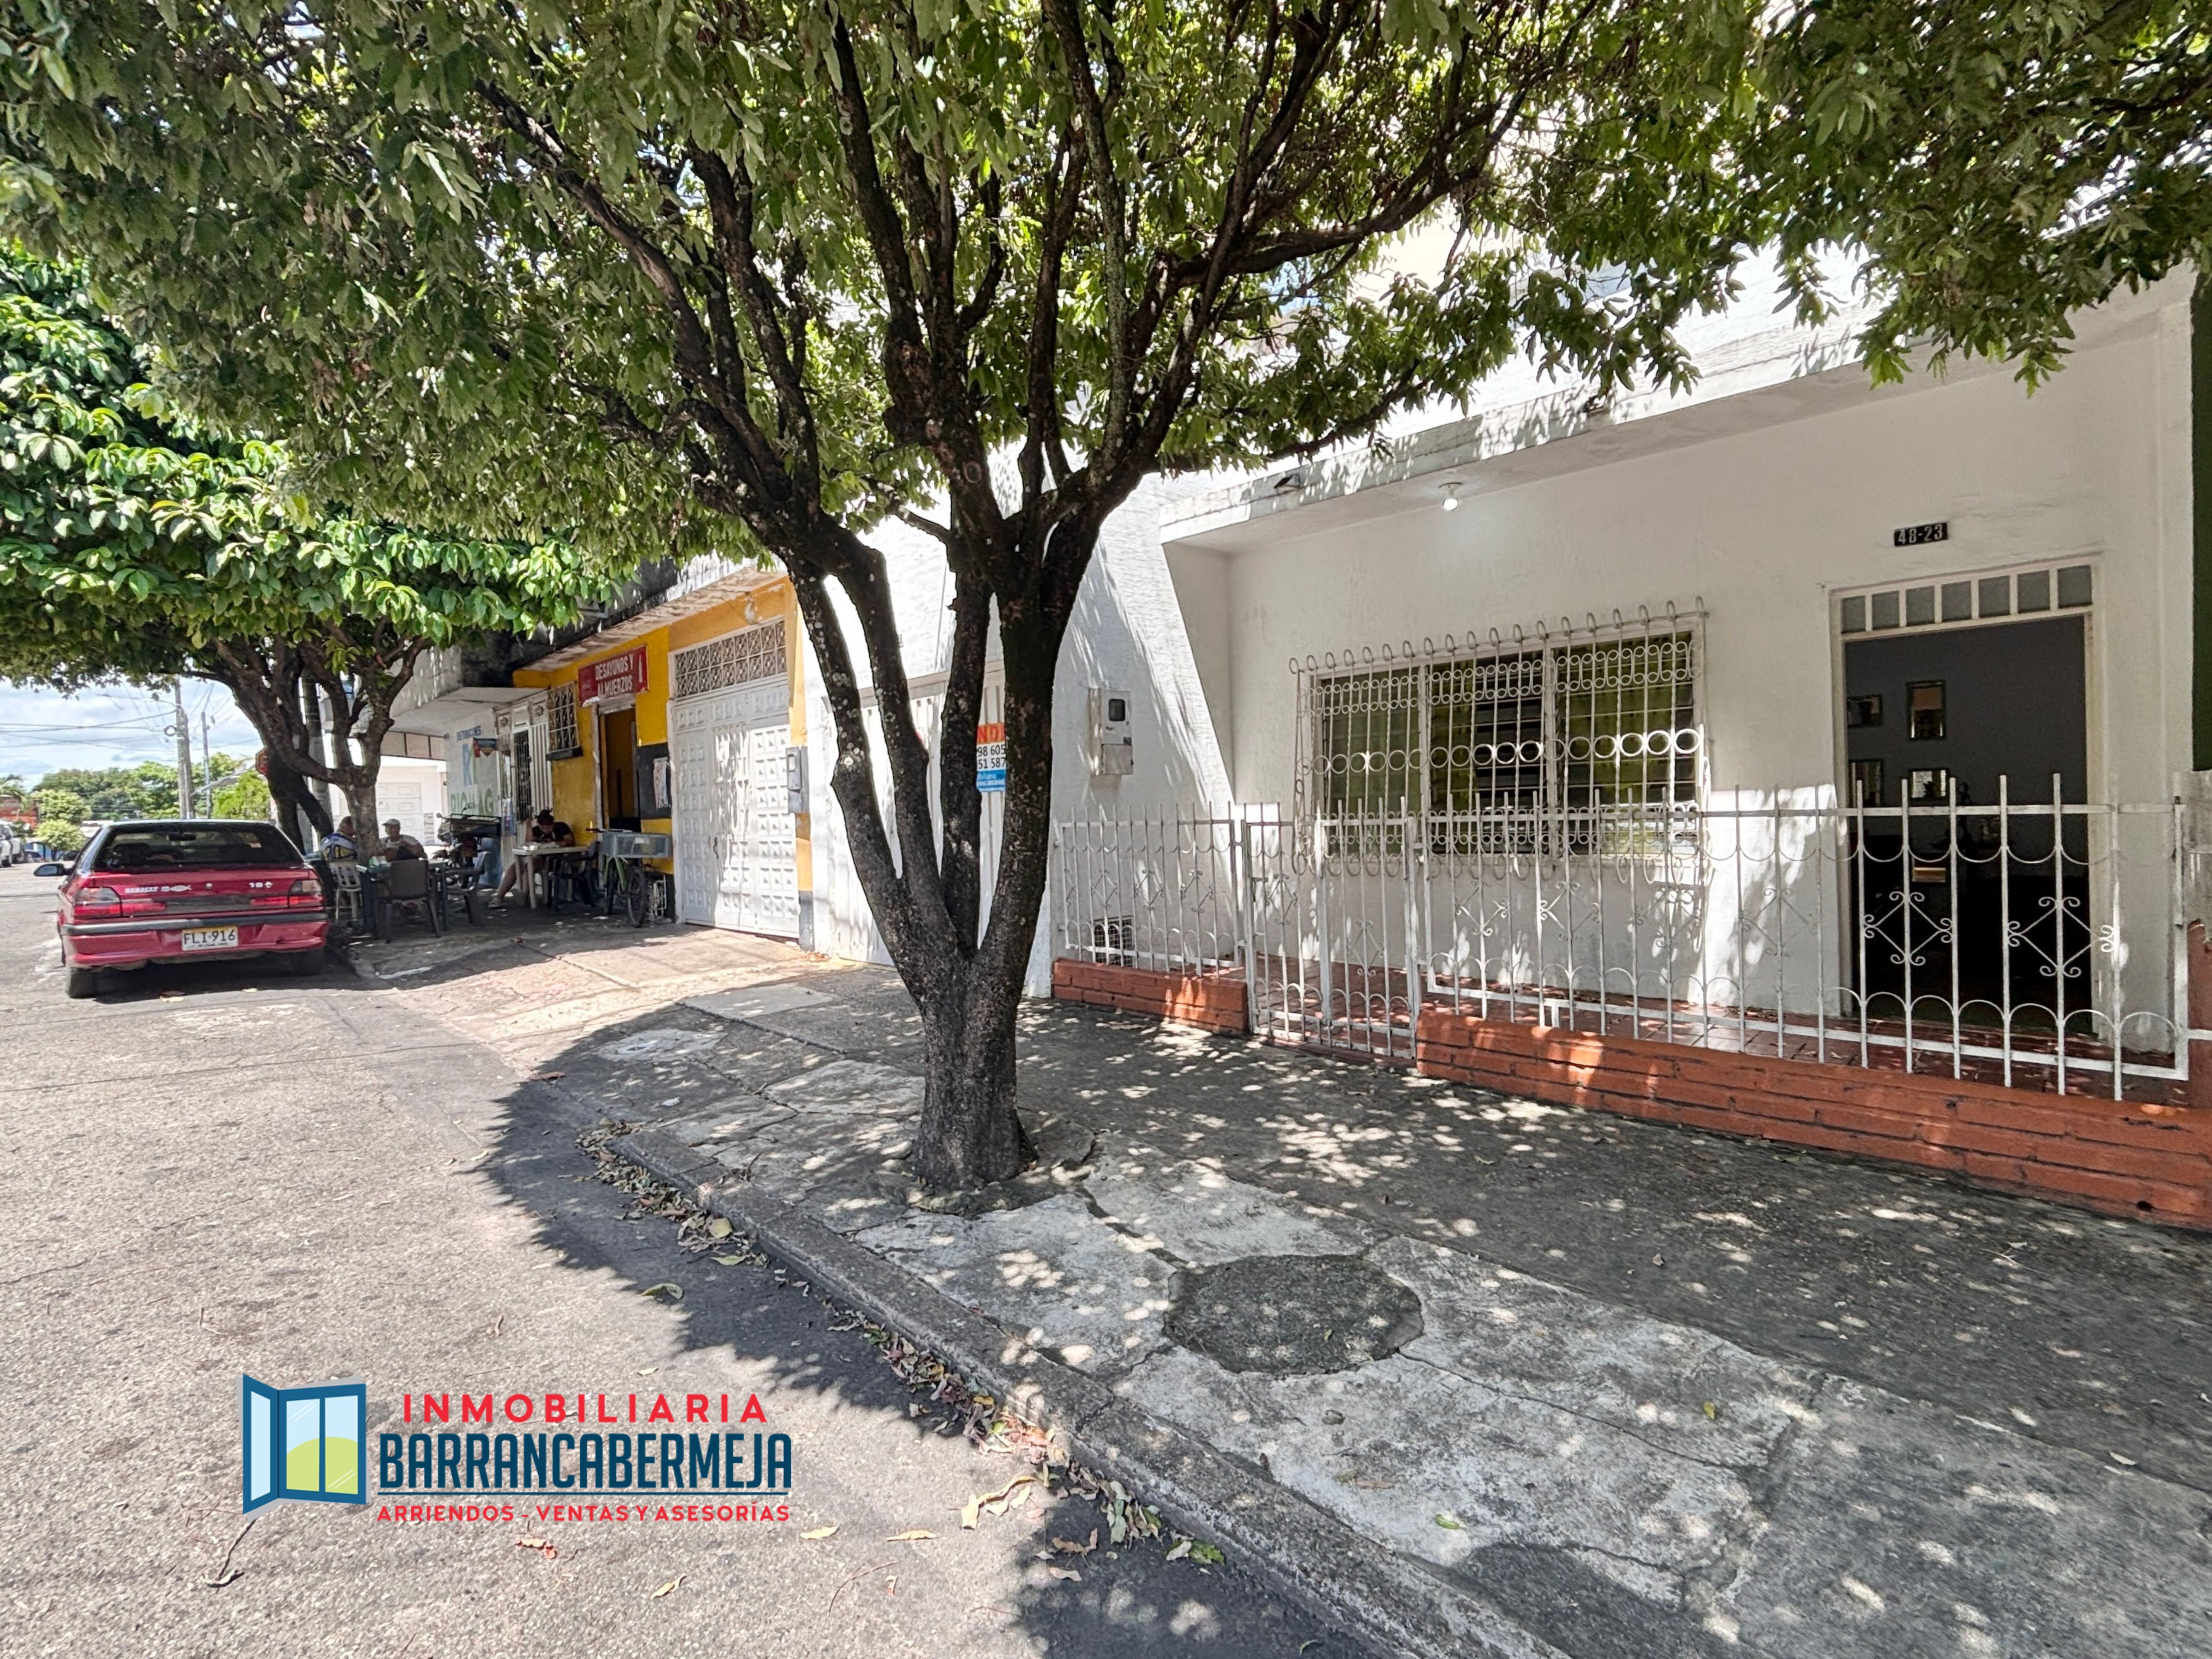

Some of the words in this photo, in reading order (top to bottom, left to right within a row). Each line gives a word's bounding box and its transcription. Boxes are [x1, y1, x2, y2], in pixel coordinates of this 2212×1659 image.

[1898, 524, 1943, 544] 48-23
[595, 656, 628, 680] DESAYUNOS
[629, 653, 633, 670] Y
[598, 675, 632, 697] ALMUERZOS
